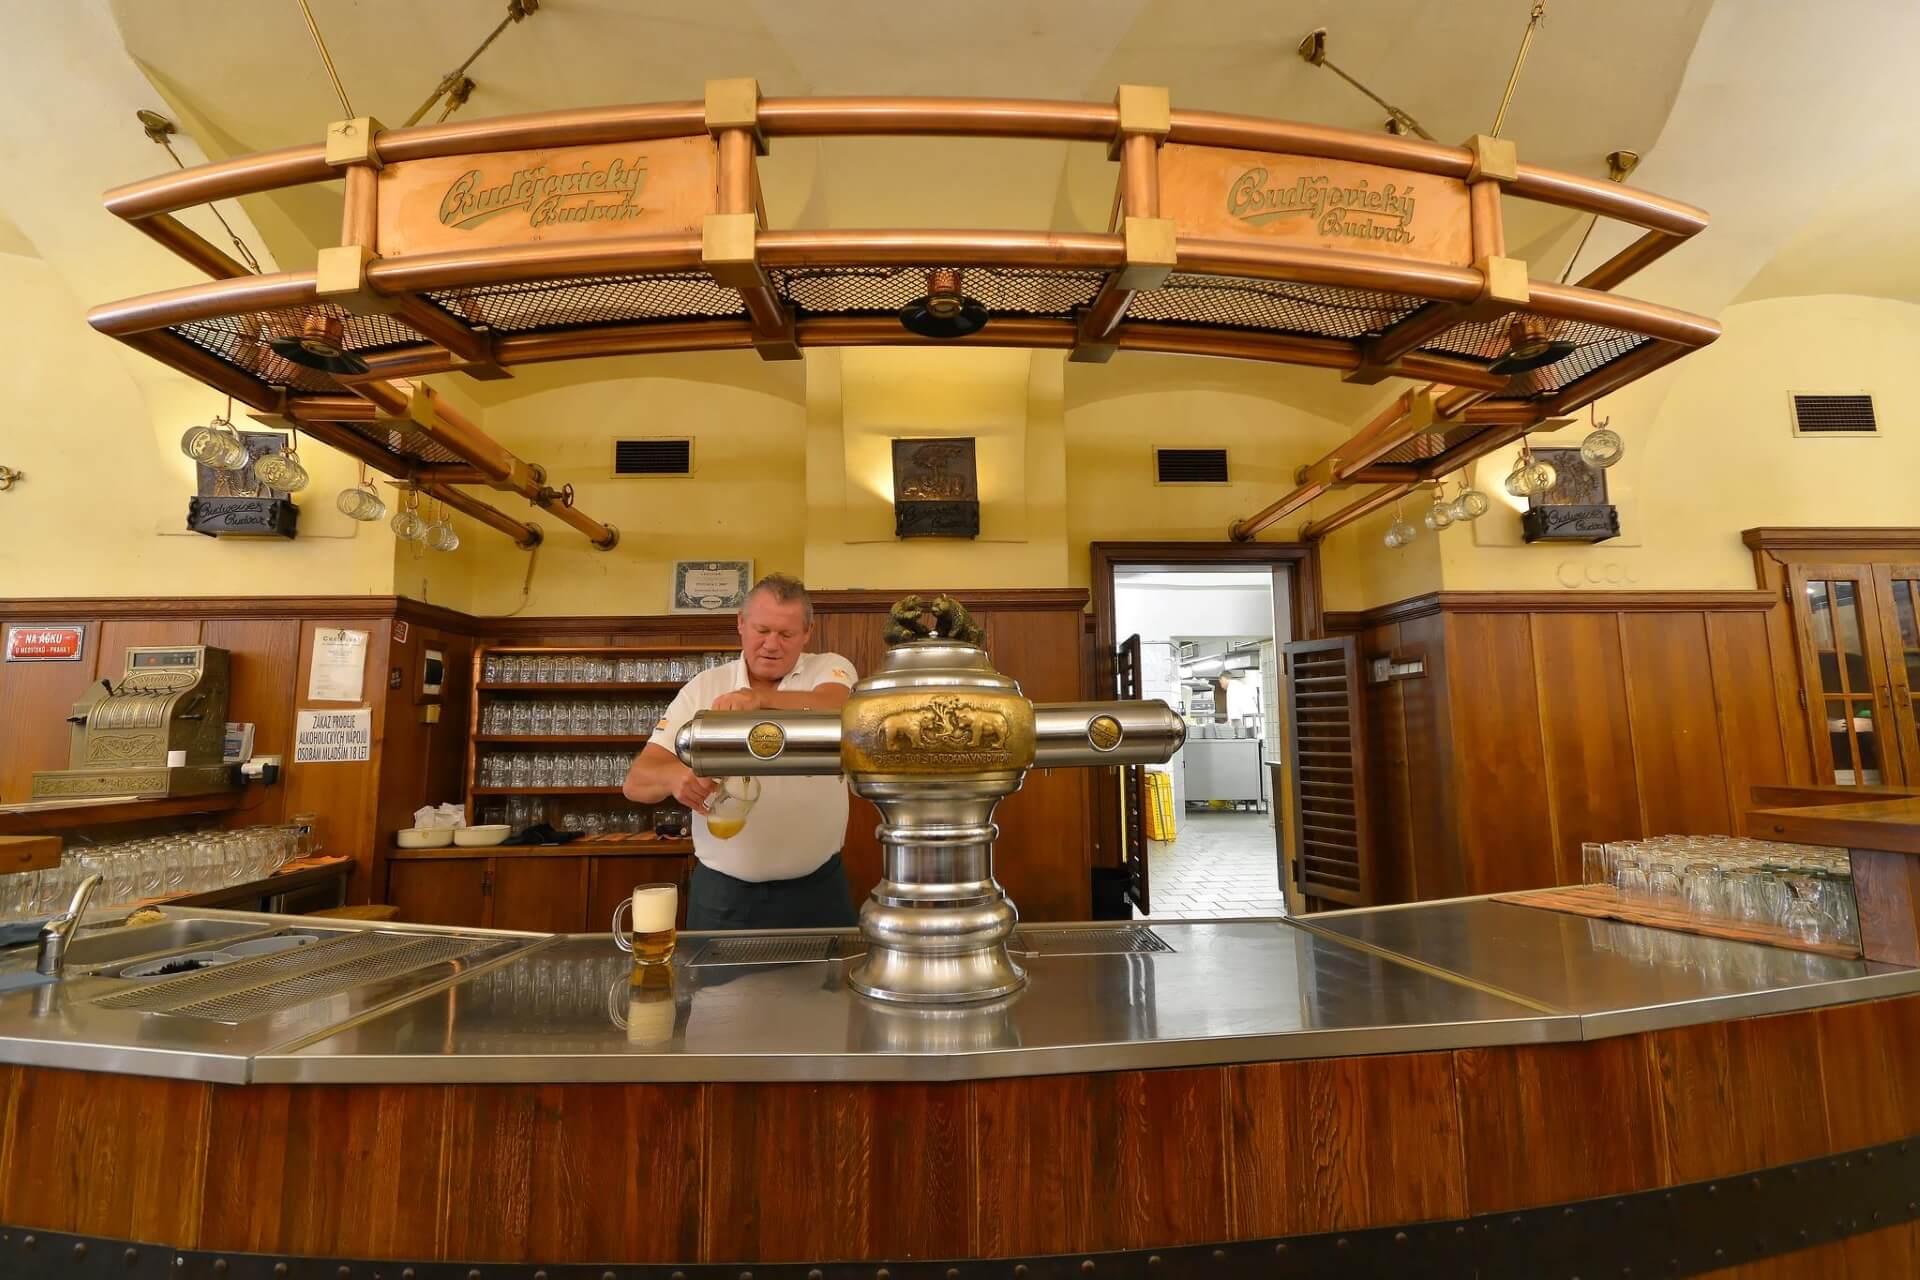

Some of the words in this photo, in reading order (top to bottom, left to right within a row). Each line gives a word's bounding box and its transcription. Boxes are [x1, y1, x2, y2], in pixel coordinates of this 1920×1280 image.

[313, 713, 331, 729] ZÁKAZ
[350, 746, 357, 760] 18
[358, 746, 368, 760] LET
